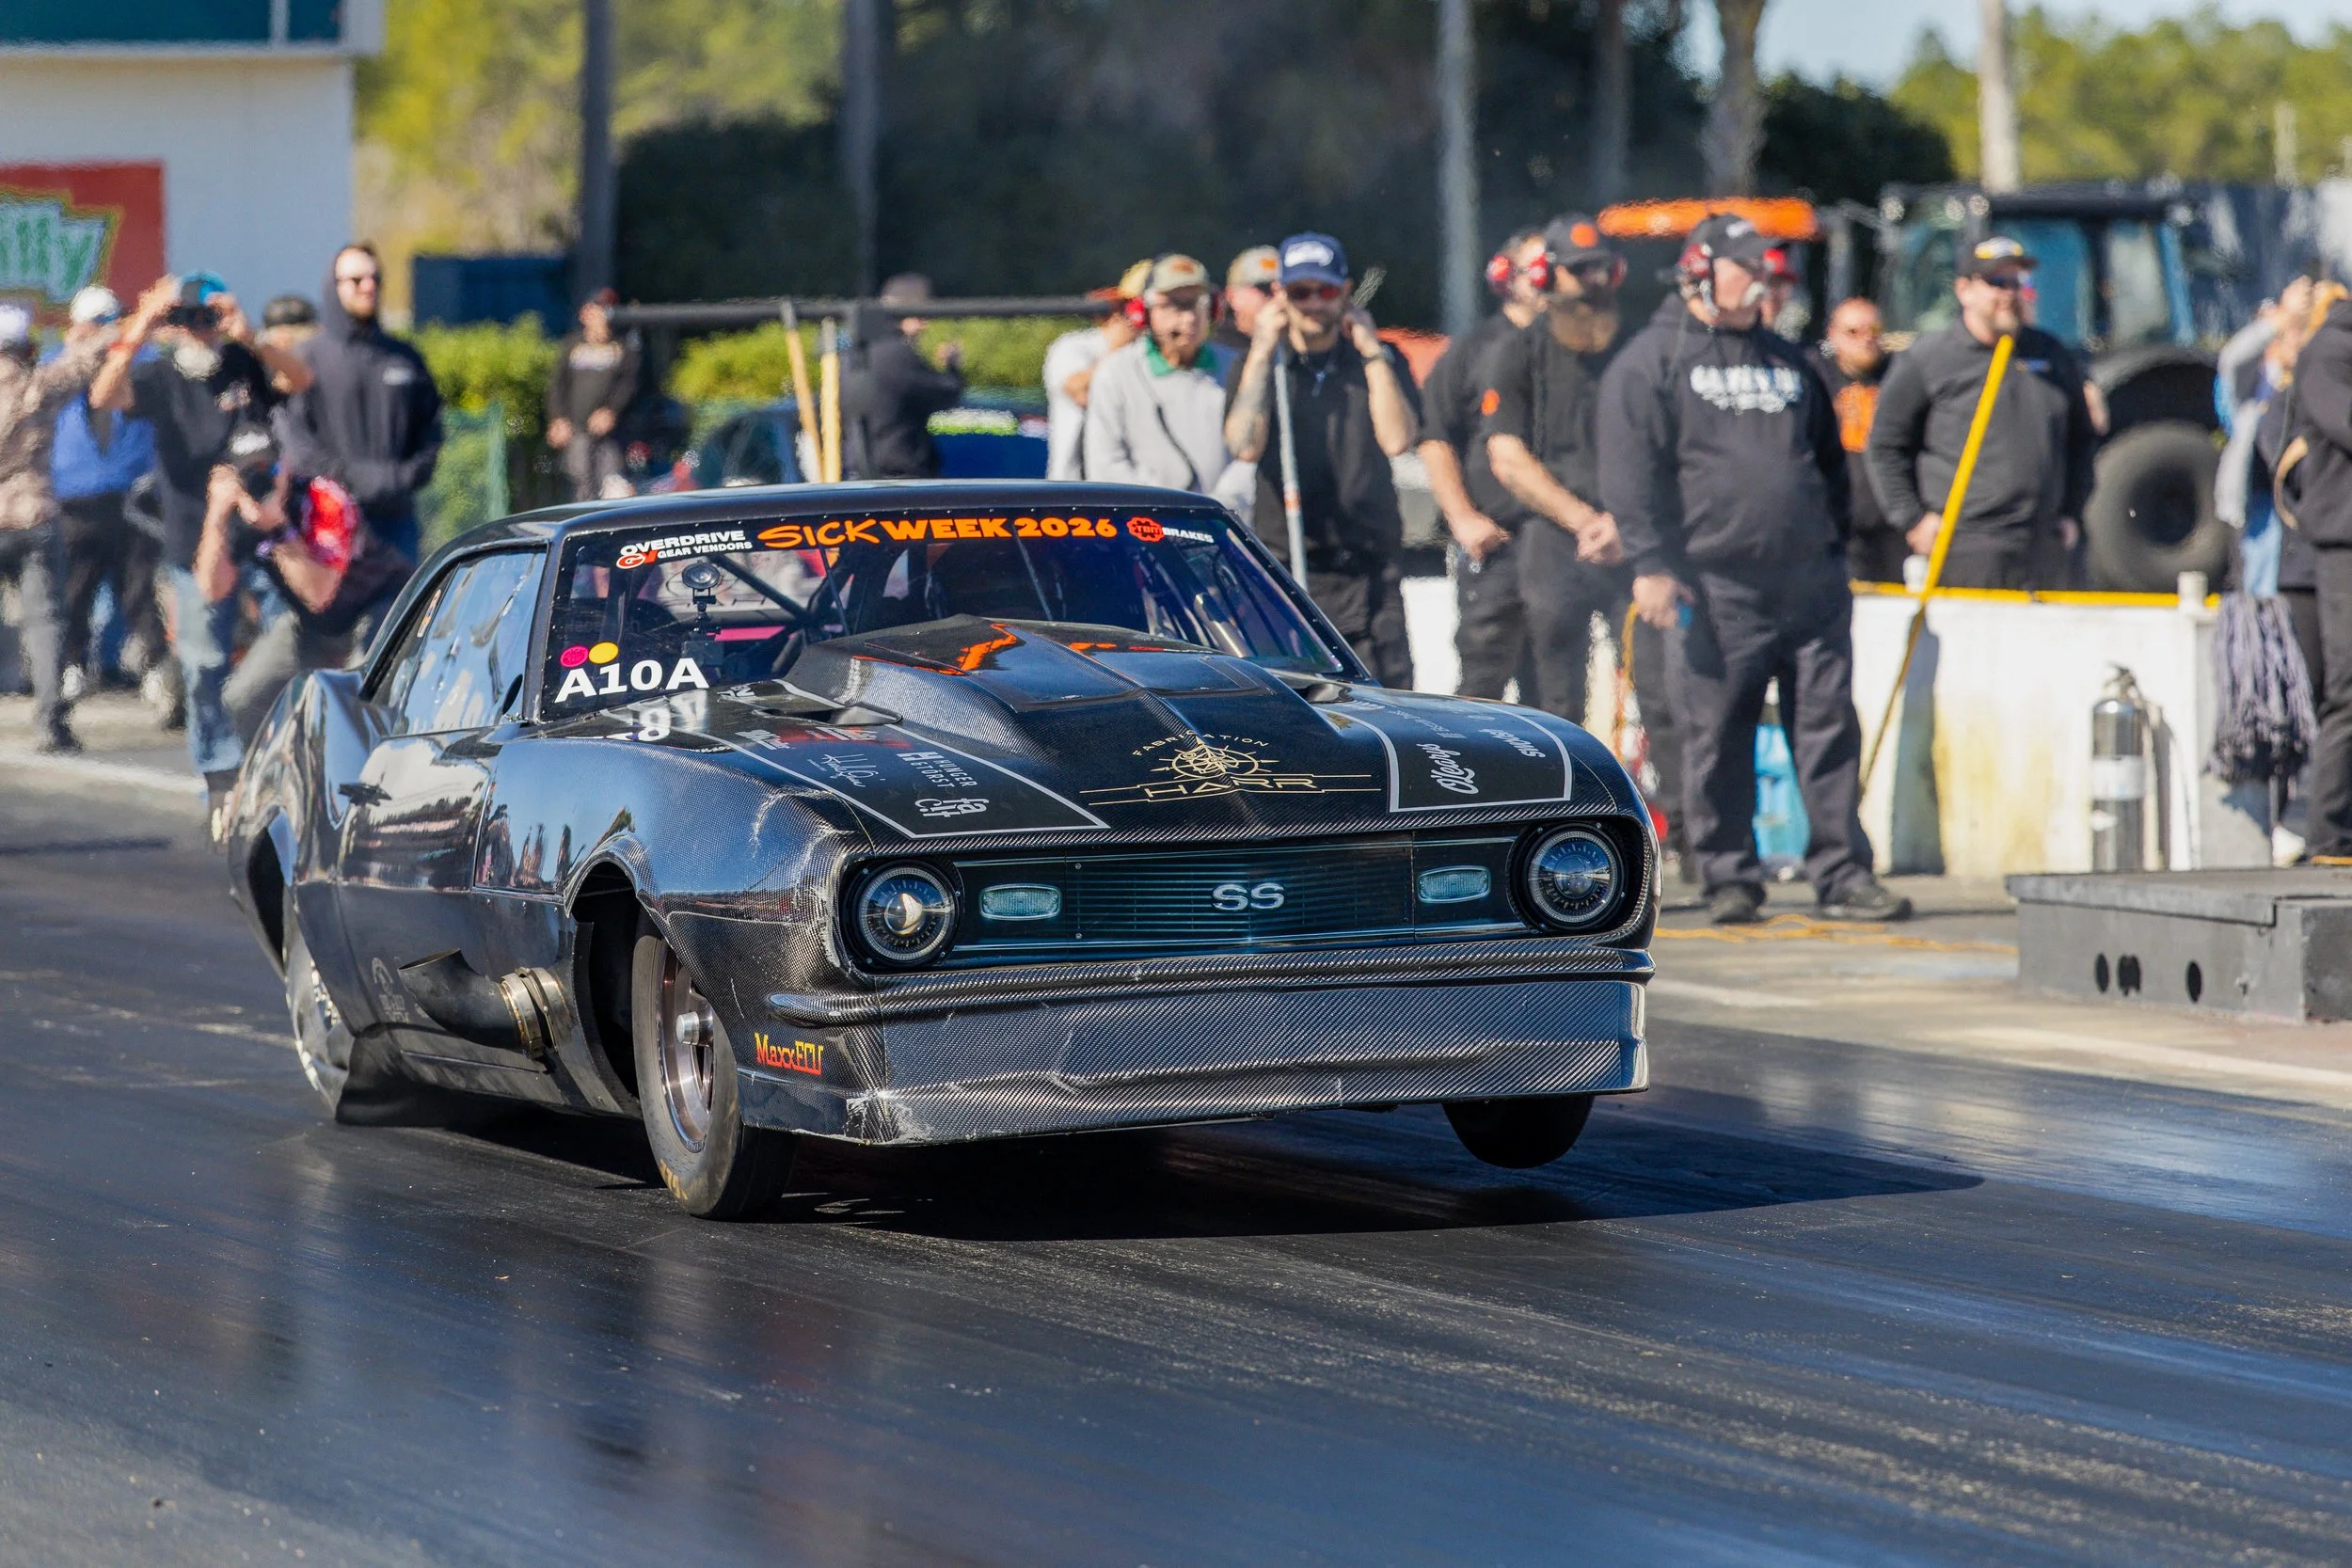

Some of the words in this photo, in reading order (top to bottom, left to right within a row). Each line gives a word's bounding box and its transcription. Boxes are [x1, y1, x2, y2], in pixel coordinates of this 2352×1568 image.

[620, 531, 746, 556] OVERDRIVE
[756, 518, 881, 548] SICK
[880, 517, 1012, 541] WEEK
[1013, 517, 1118, 539] 2026
[1162, 527, 1215, 544] BRAKES
[657, 547, 691, 559] GEAR
[692, 541, 753, 554] VENDORS
[554, 657, 709, 703] A10A
[1132, 730, 1269, 756] FABRICATION
[933, 759, 977, 787] HUNGER
[1144, 776, 1317, 798] HARR
[1212, 882, 1284, 911] SS
[755, 1032, 823, 1076] MaxxECU
